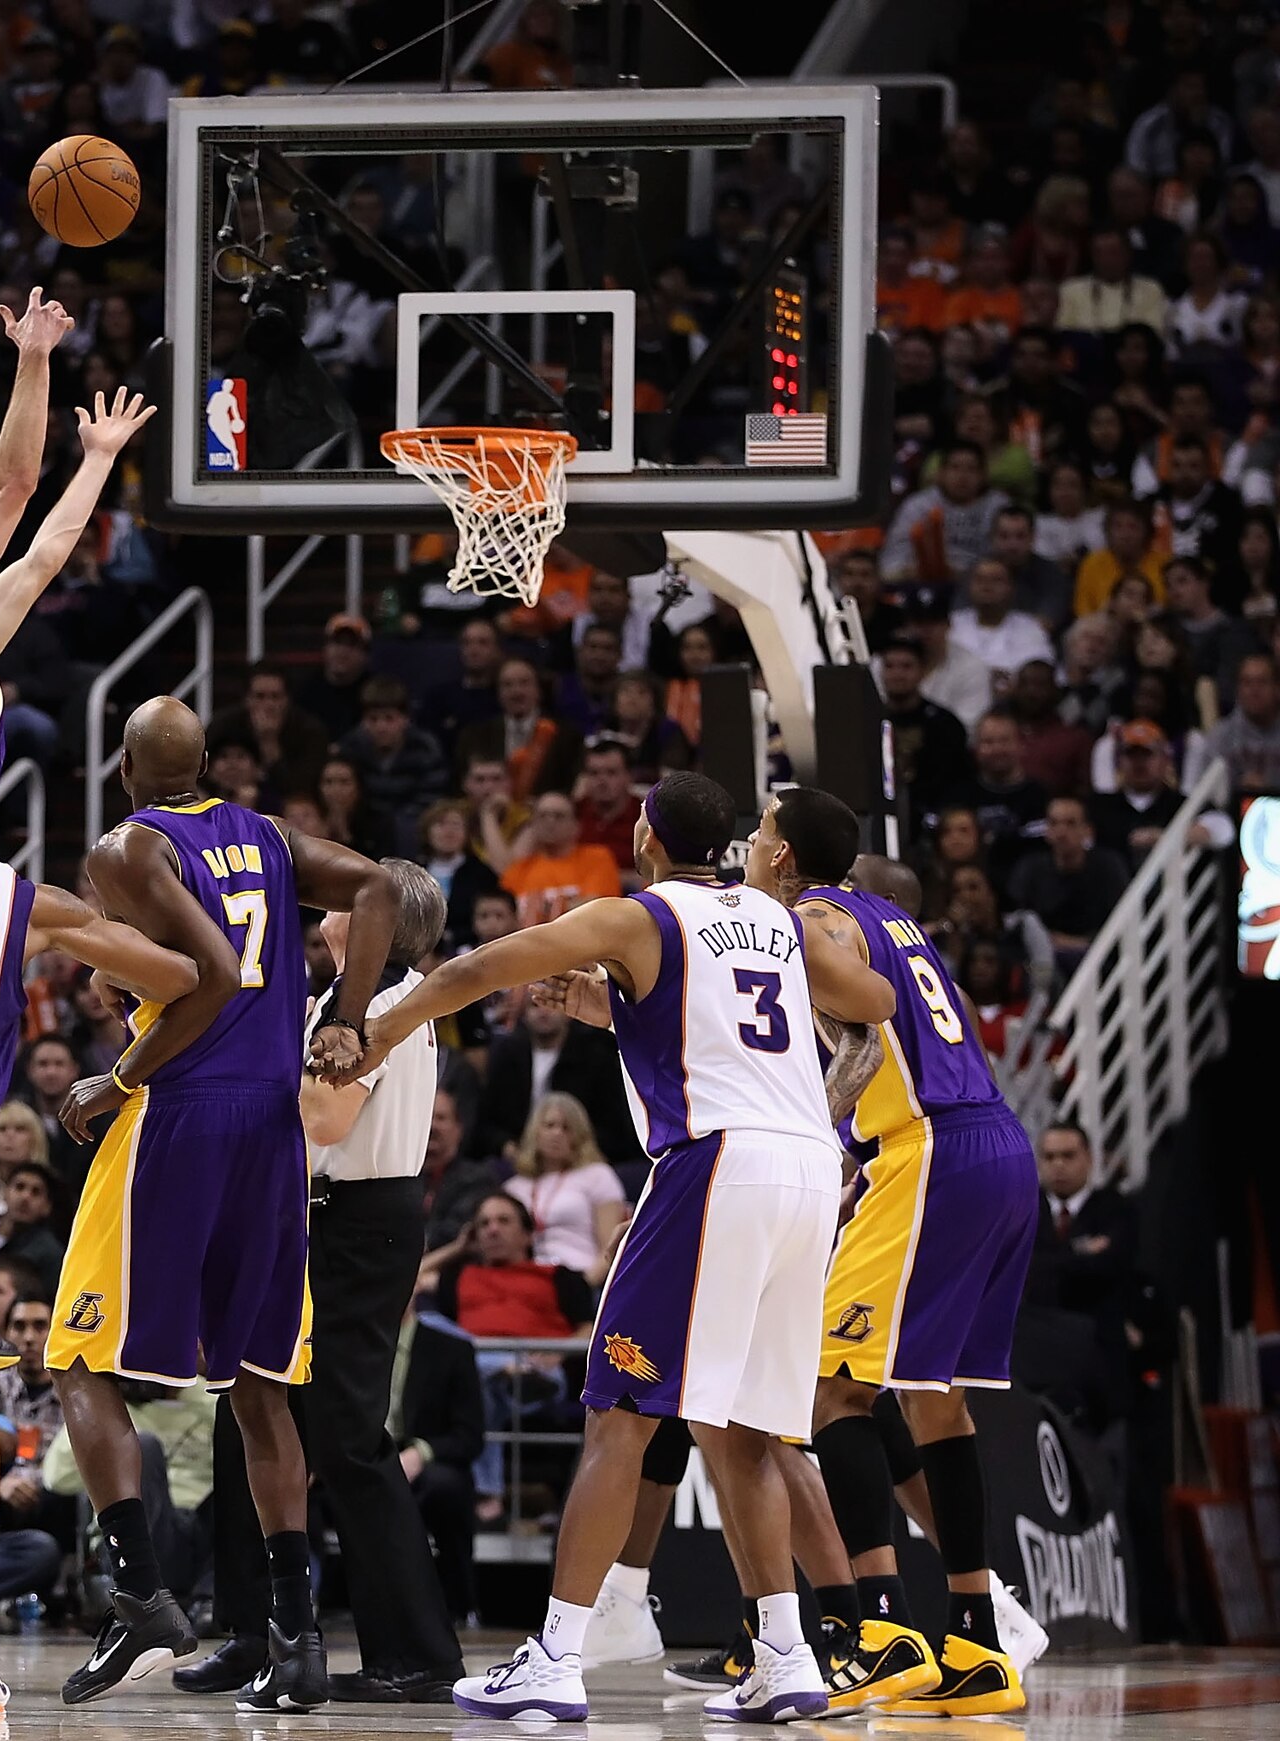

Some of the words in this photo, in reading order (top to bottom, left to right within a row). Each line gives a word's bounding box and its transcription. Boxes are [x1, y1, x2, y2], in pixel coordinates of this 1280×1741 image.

[209, 452, 233, 467] NBA
[221, 889, 269, 988] 7
[697, 921, 801, 964] DUDLEY
[731, 967, 791, 1054] 3
[907, 954, 964, 1044] 9
